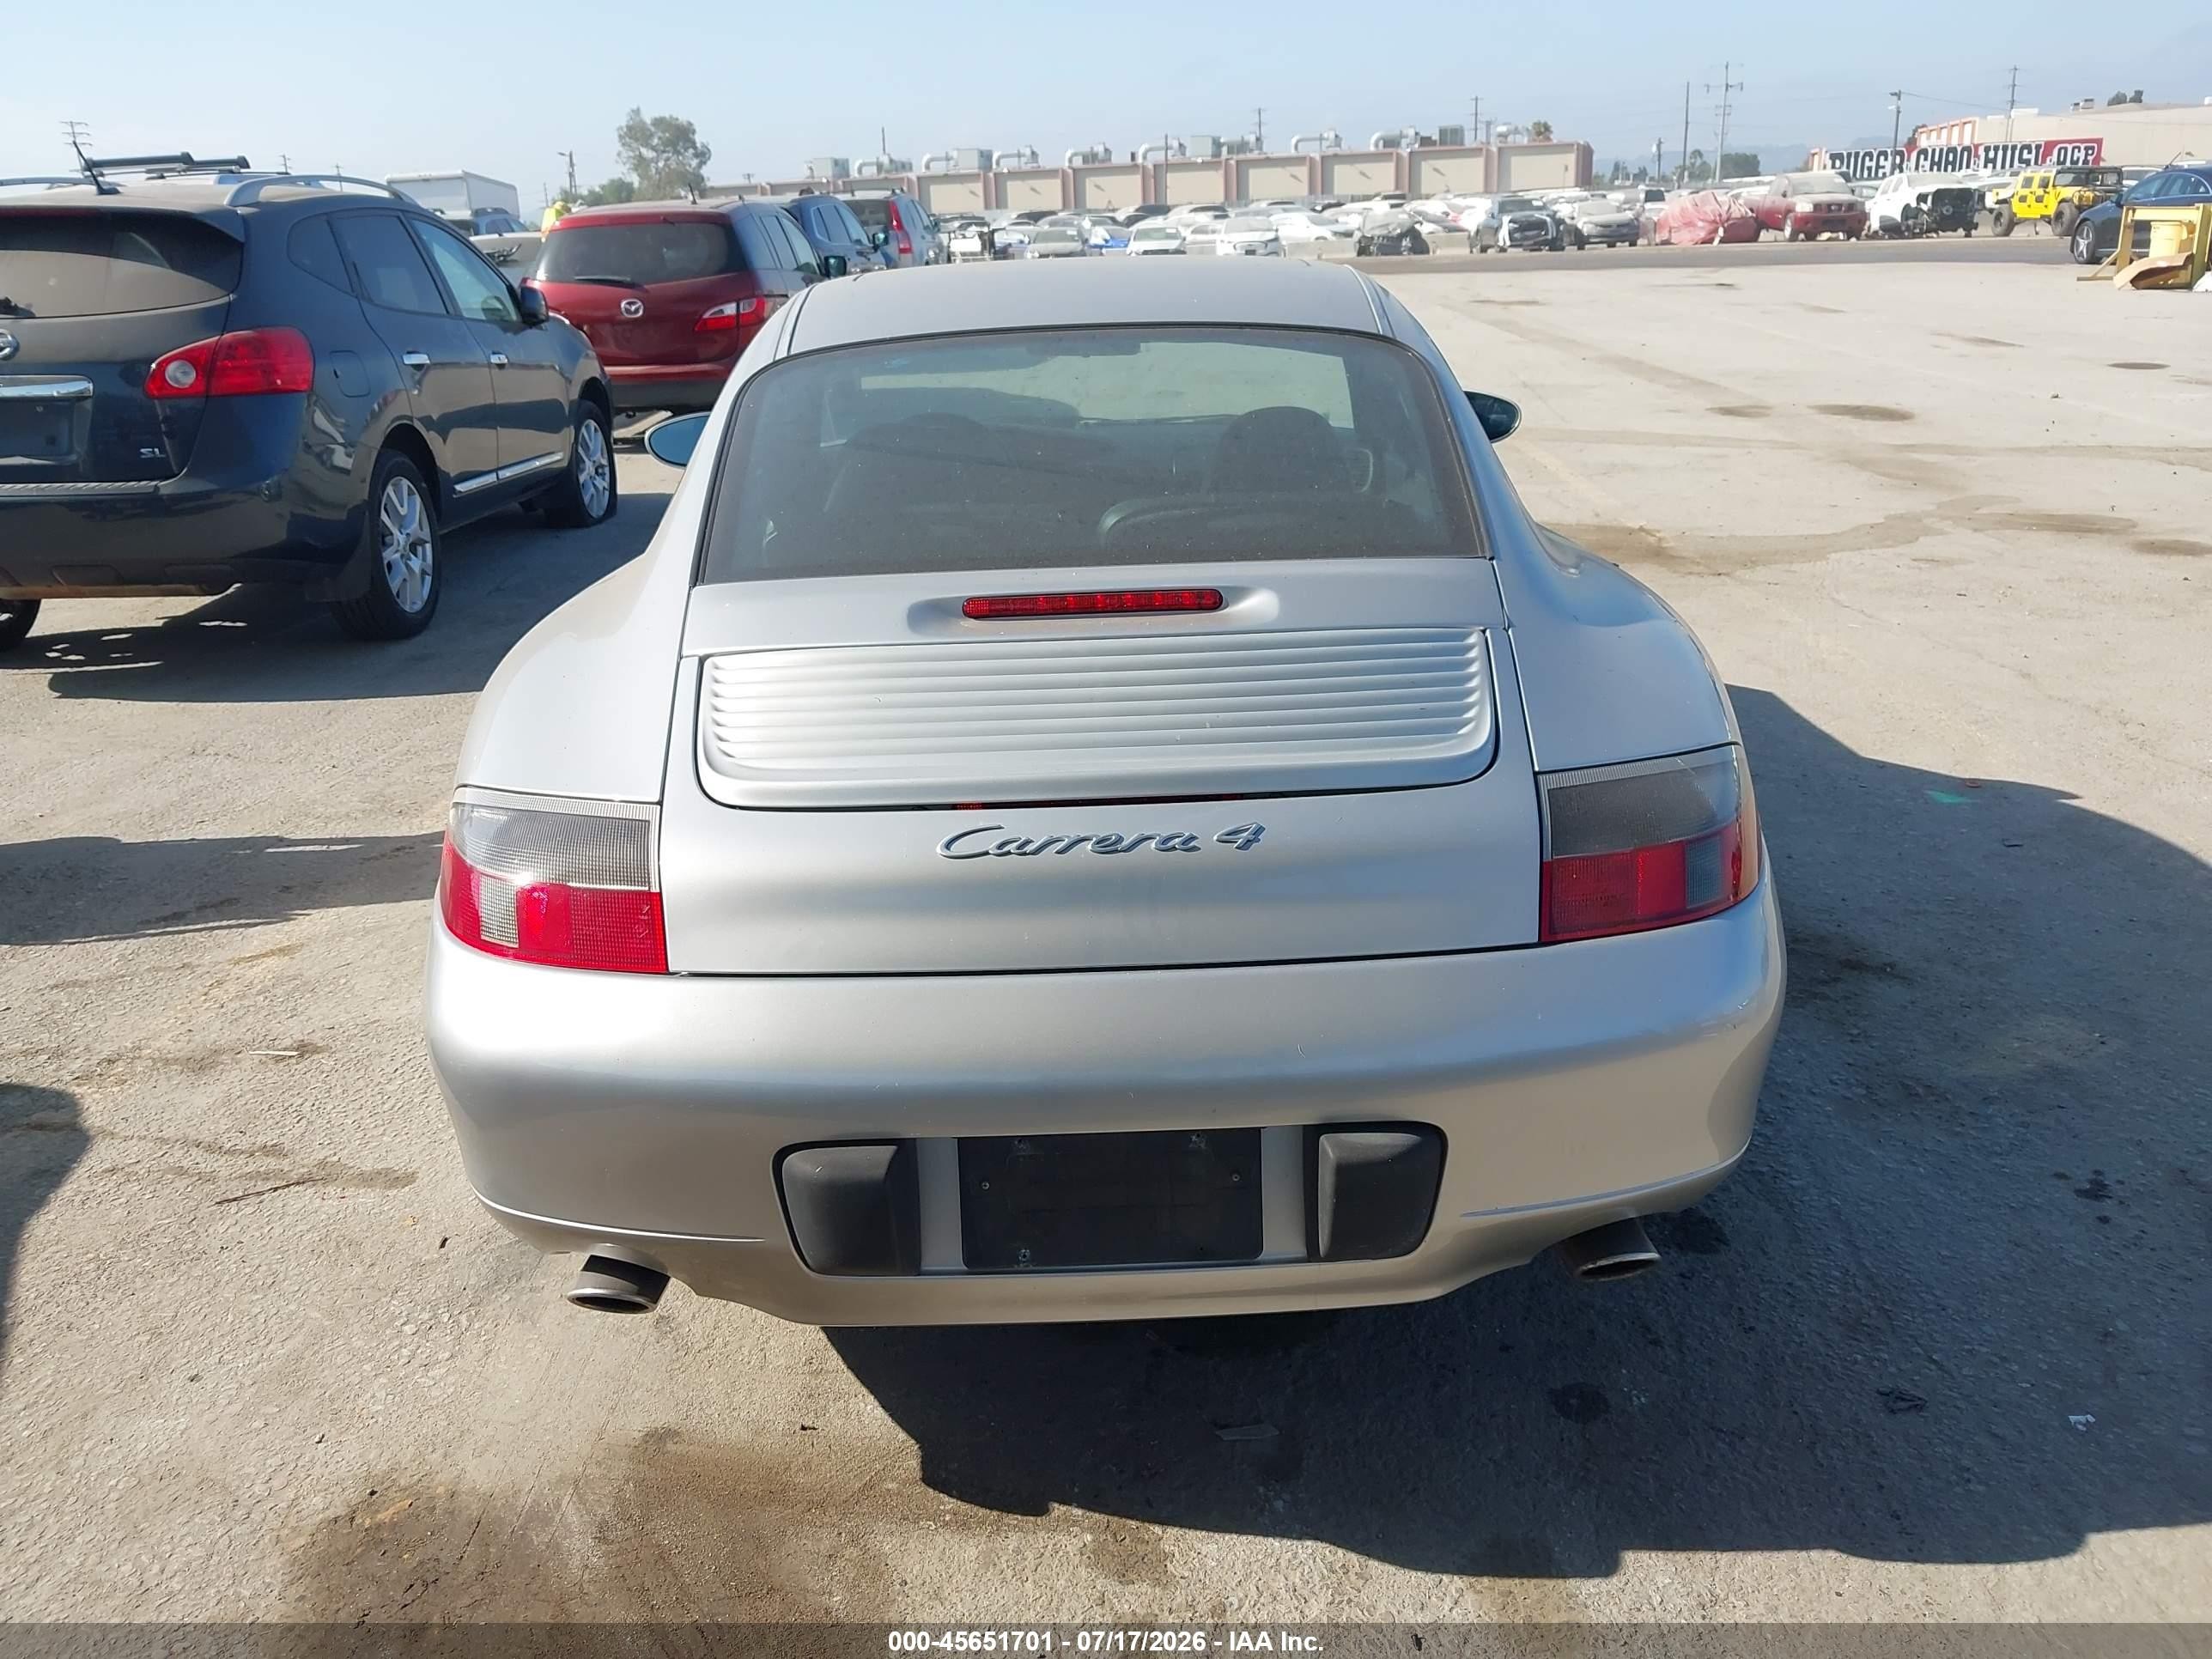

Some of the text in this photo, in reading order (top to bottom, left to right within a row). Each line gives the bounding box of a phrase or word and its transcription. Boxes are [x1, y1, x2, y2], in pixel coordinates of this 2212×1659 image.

[140, 447, 166, 459] SL
[936, 821, 1267, 860] Carrera 4
